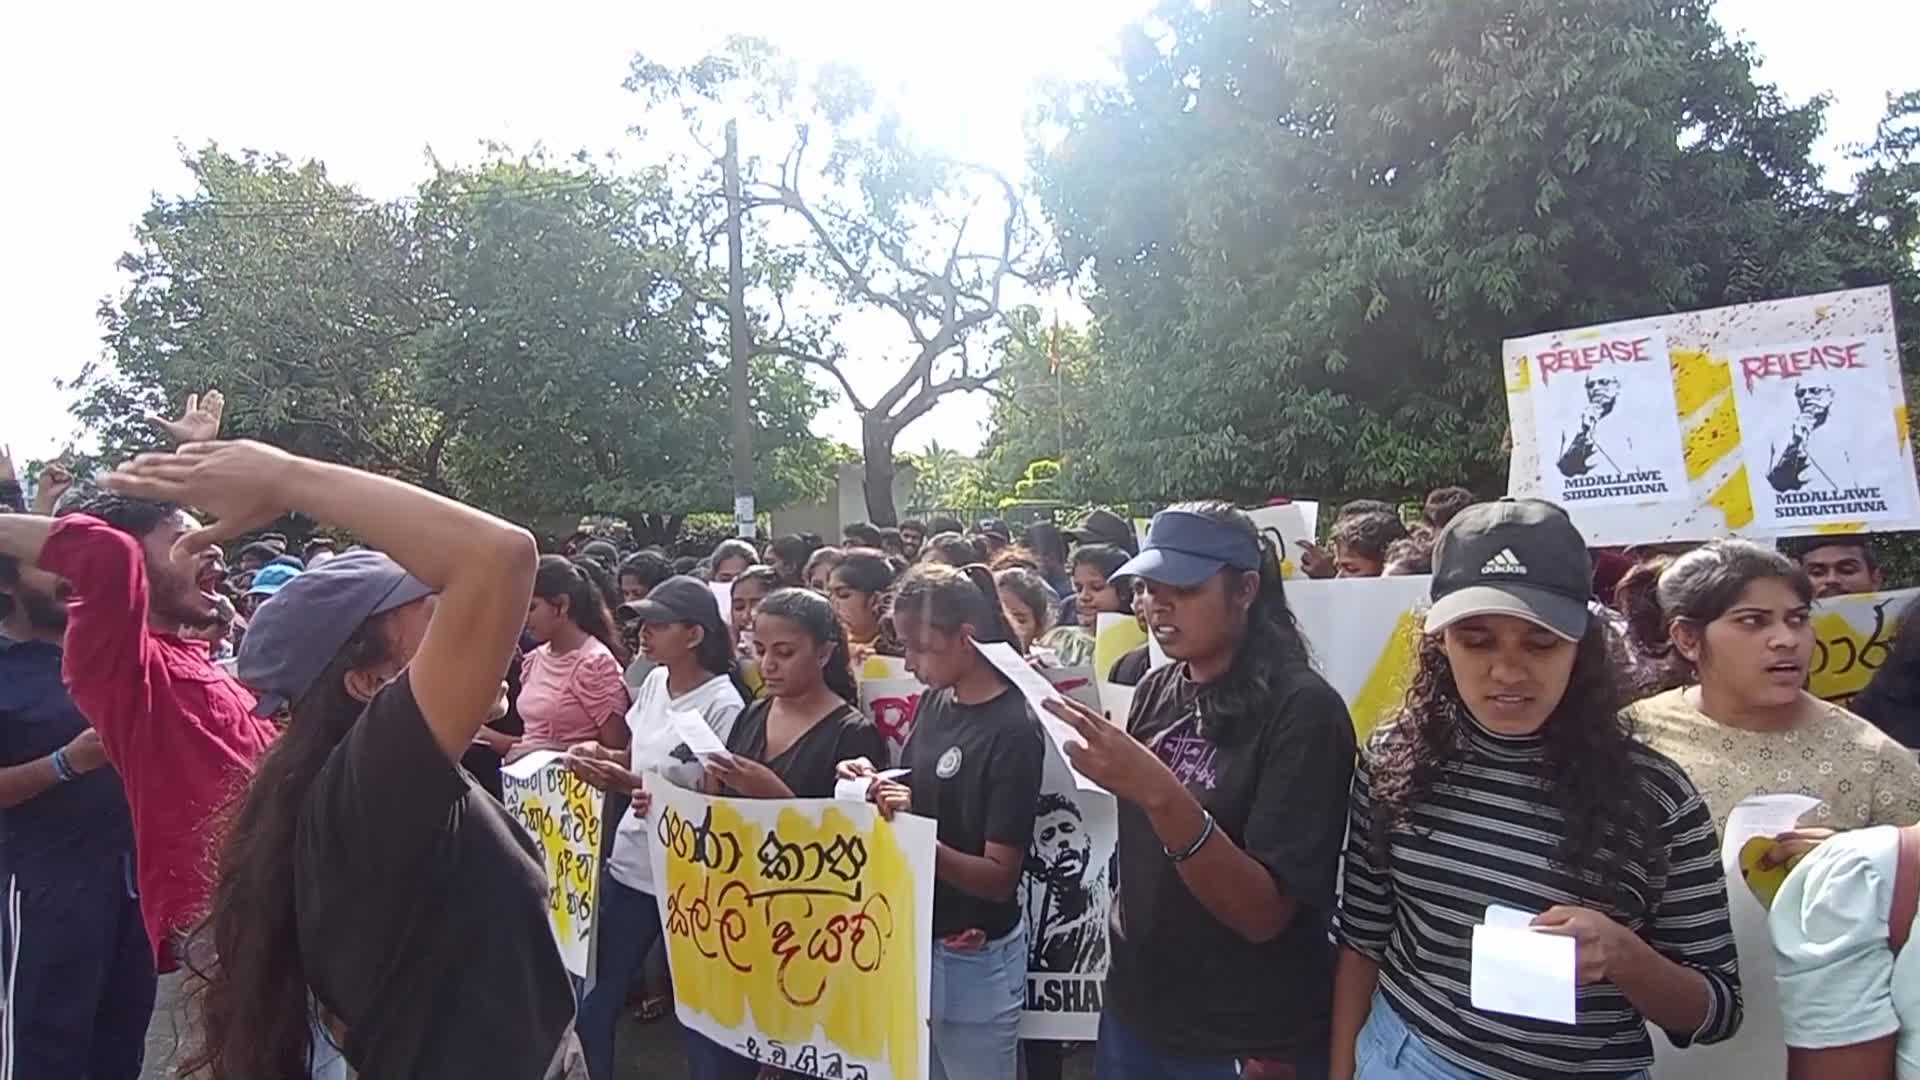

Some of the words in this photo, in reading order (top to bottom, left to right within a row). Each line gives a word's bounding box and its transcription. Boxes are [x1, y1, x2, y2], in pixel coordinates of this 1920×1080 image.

[1536, 337, 1652, 387] RELEASE
[1739, 342, 1868, 395] RELEASE
[1564, 470, 1662, 489] MIDALLAWE
[1563, 482, 1668, 501] SIRIRATHANA
[1776, 487, 1881, 505] MIDALLAWE
[1774, 500, 1888, 518] SIRIRATHANA
[1481, 563, 1527, 574] adidas
